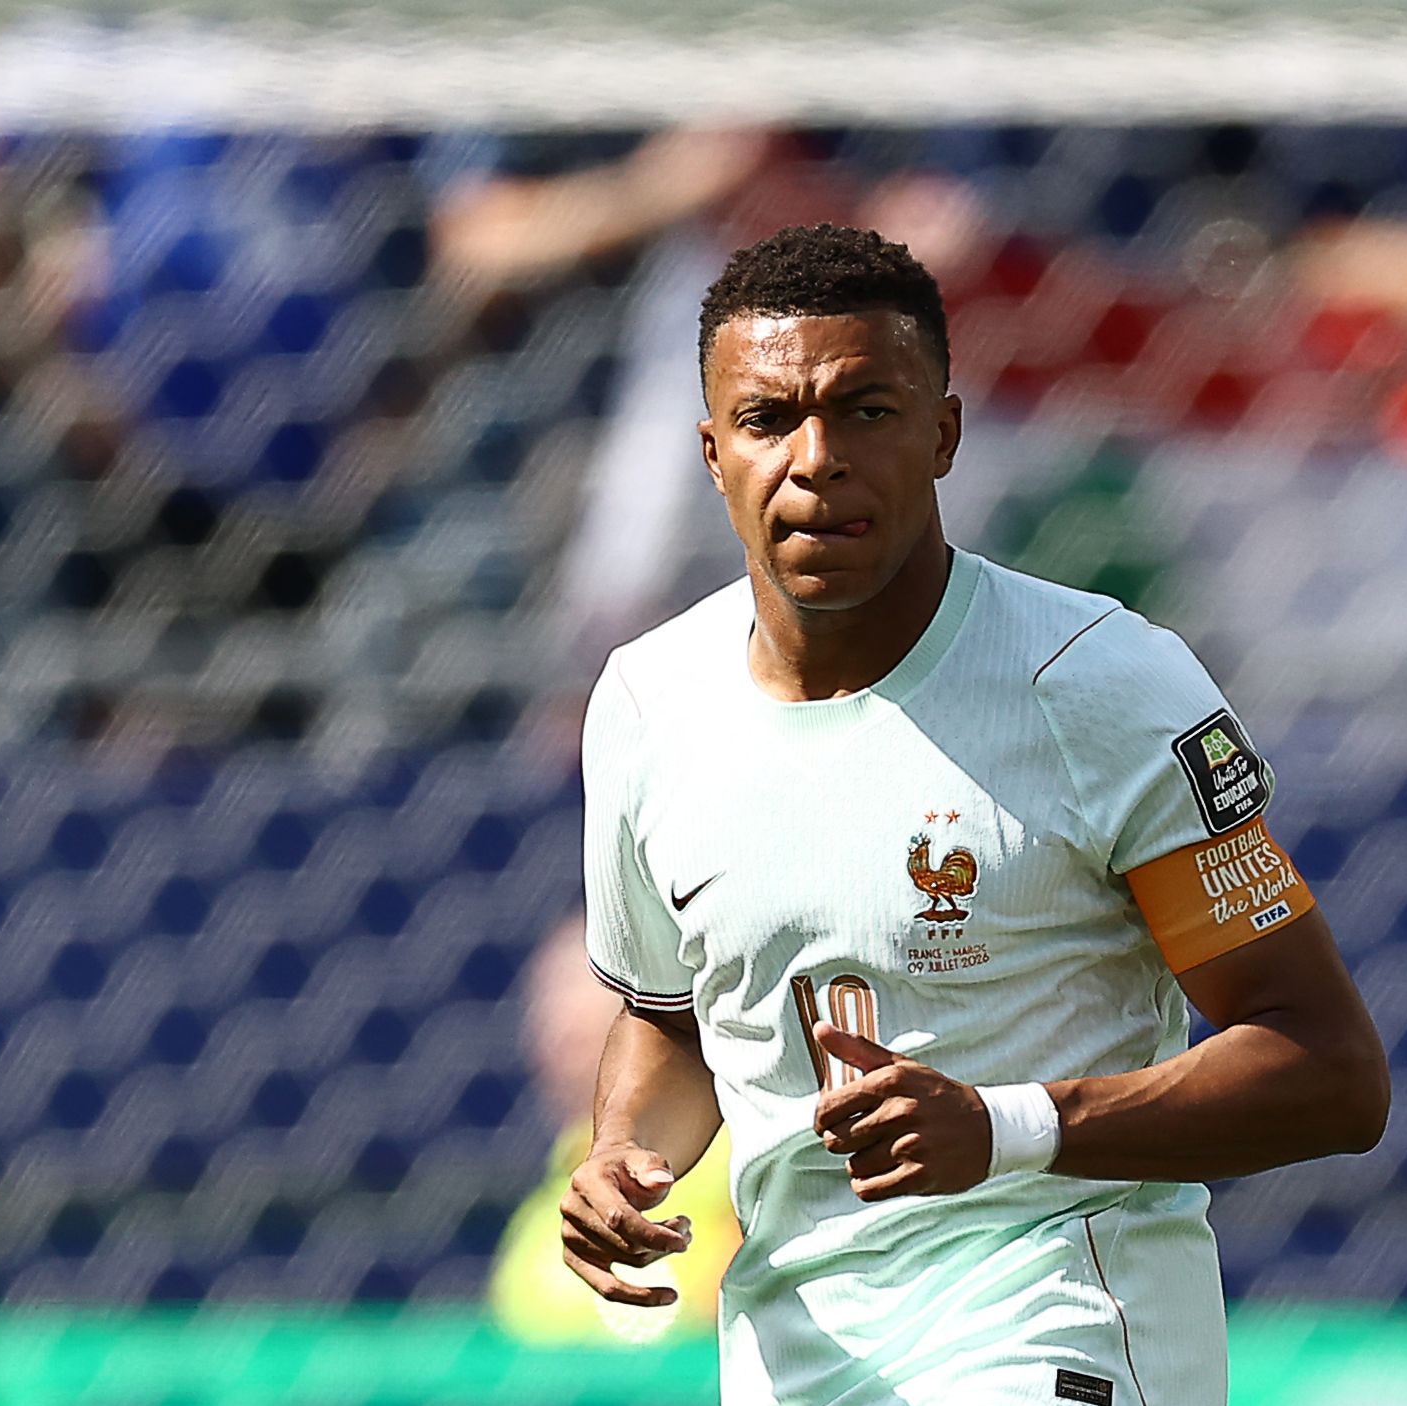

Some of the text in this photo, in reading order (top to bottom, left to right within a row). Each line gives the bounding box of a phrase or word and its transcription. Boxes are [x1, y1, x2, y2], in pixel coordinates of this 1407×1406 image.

[1212, 765, 1237, 790] Unite
[1235, 797, 1254, 815] FIFA
[1195, 823, 1265, 873] FOOTBALL
[1200, 842, 1282, 898] UNITES
[1208, 863, 1299, 925] the World
[1254, 905, 1289, 929] FIFA
[907, 952, 990, 974] 09 JUILLET 2026
[908, 948, 942, 960] FRANCE
[952, 943, 987, 956] MAROC
[790, 974, 876, 1094] 10
